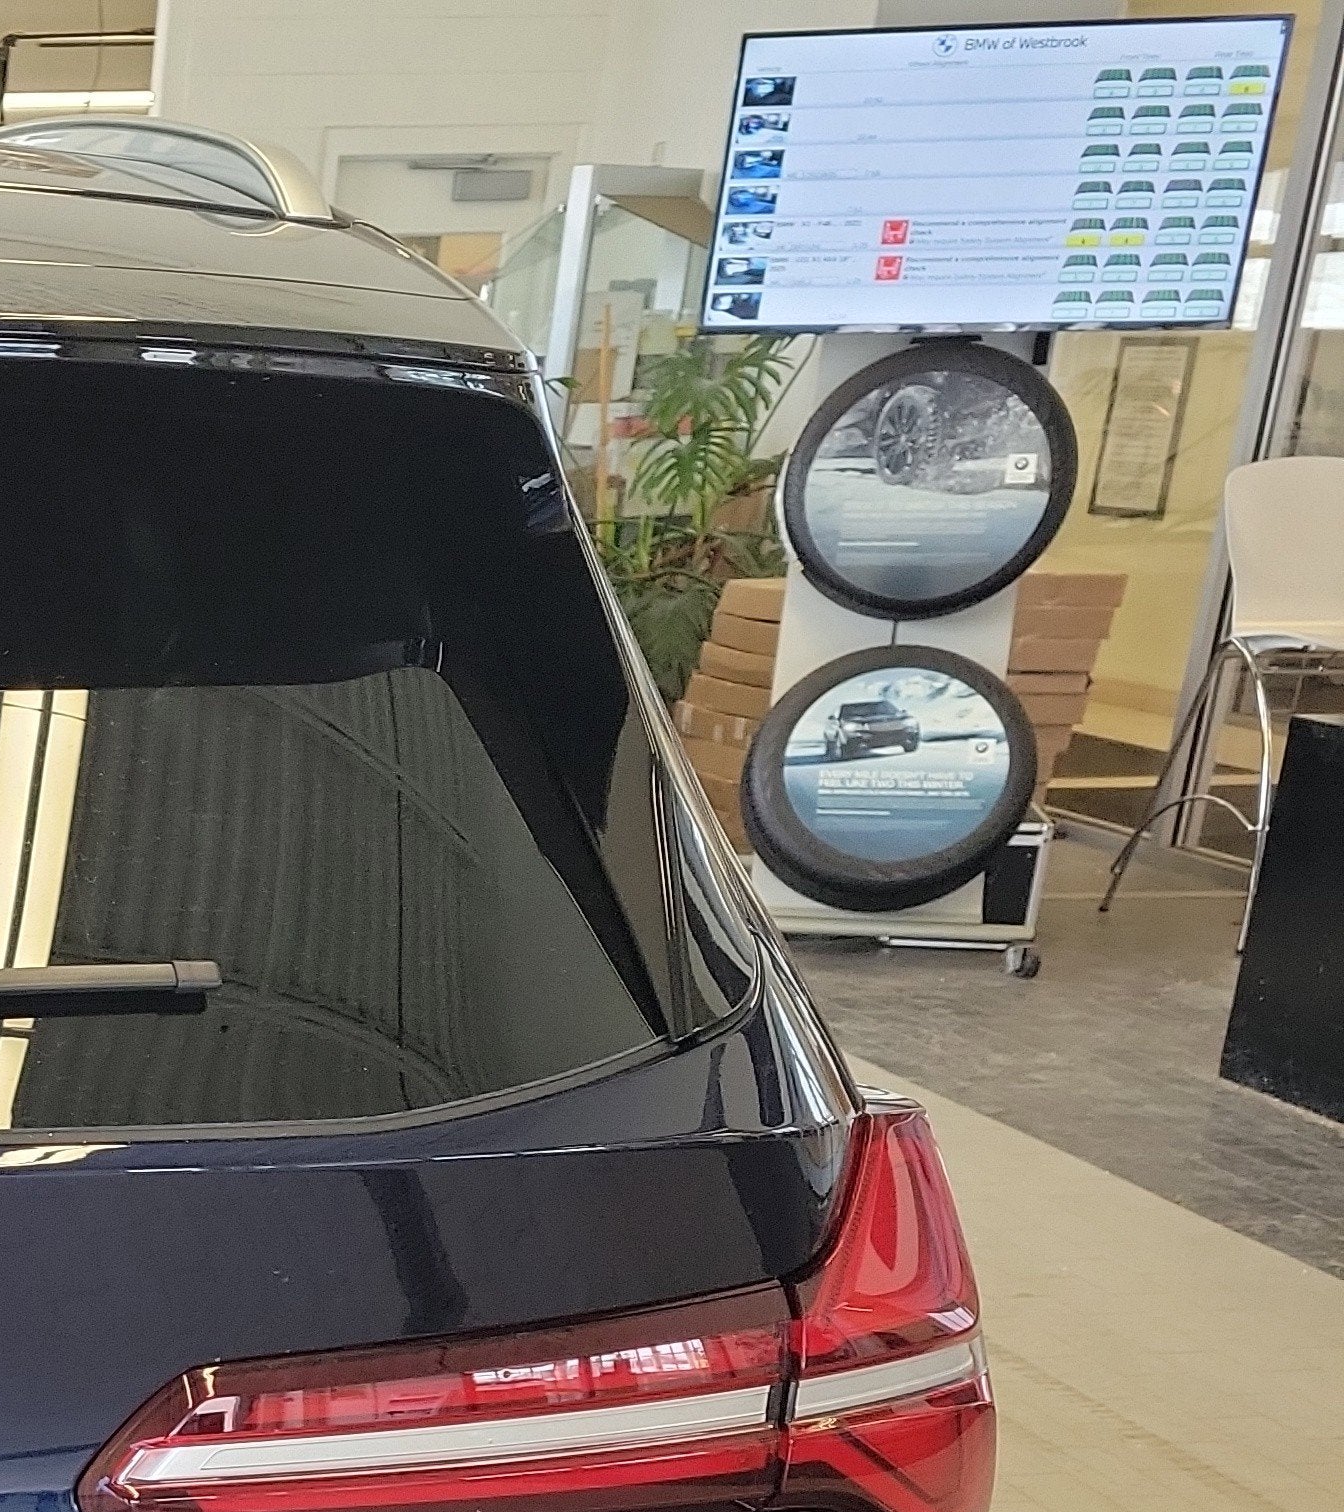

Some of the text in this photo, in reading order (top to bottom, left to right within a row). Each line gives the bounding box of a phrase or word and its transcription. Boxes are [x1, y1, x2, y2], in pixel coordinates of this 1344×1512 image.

[964, 34, 1088, 51] BMW of Westbrook
